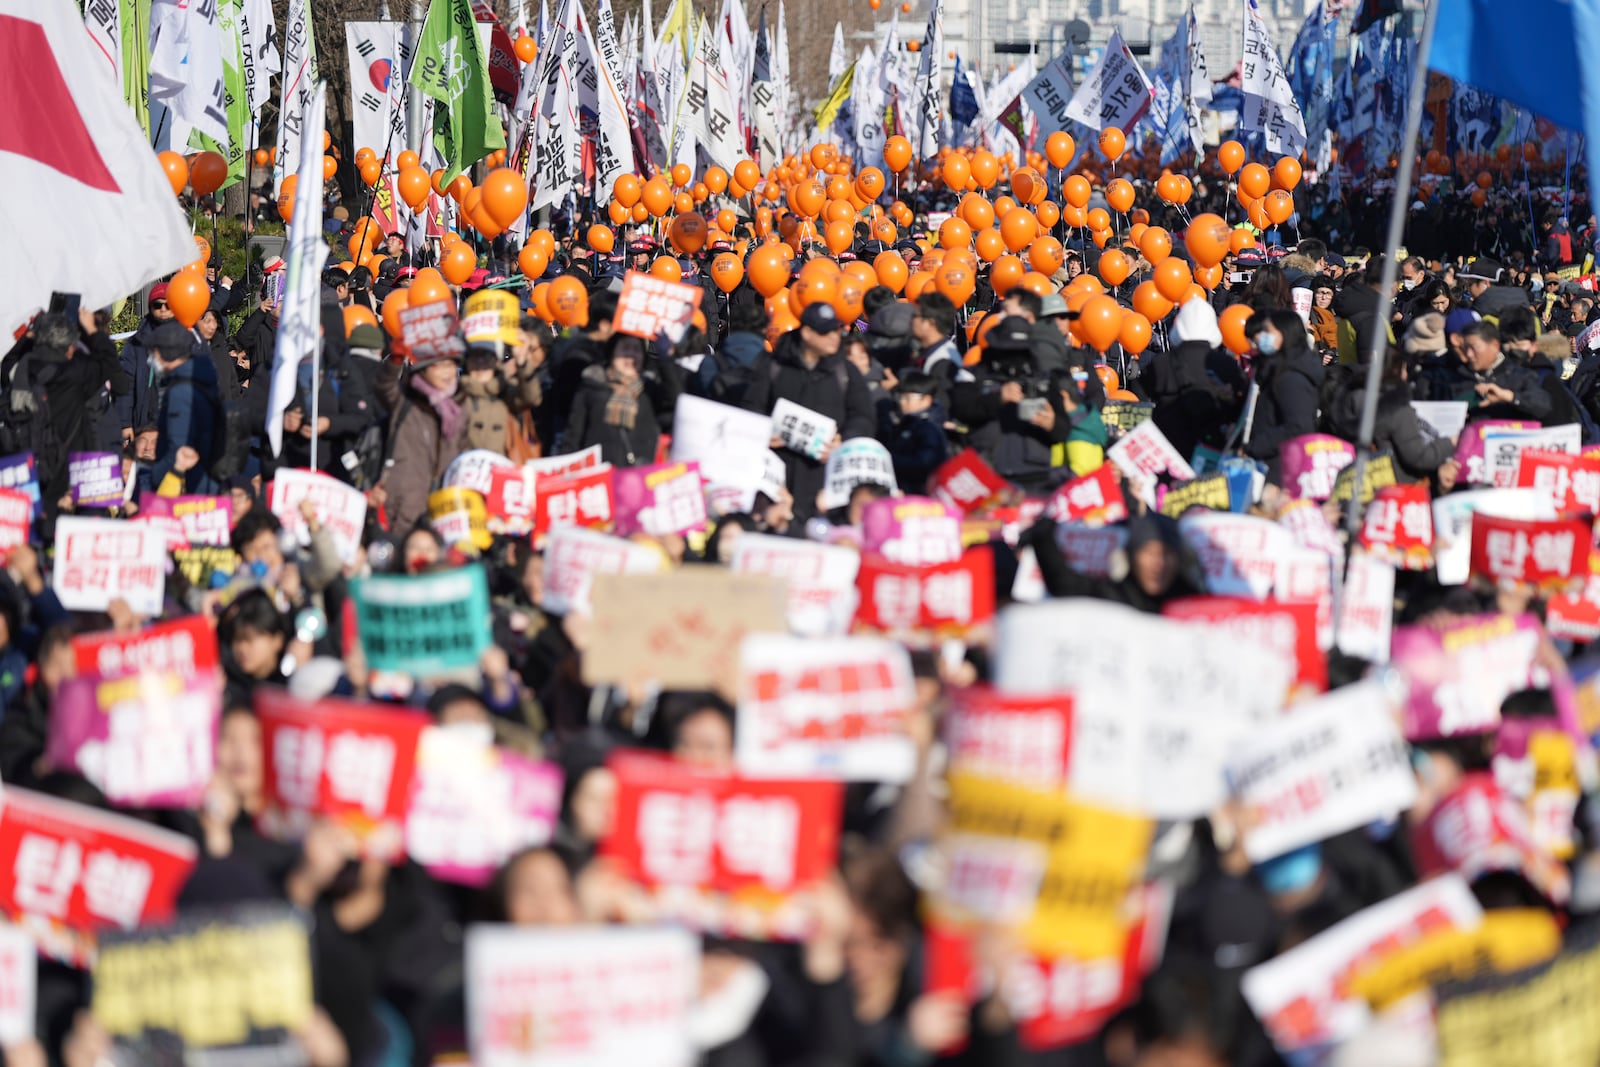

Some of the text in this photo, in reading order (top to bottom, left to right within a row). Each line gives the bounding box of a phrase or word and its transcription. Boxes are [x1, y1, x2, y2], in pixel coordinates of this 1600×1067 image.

[546, 483, 611, 528] 탄핵
[1534, 465, 1600, 515] 탄핵
[1364, 499, 1434, 546] 탄핵
[1486, 529, 1576, 579] 탄핵
[873, 568, 974, 628] 탄핵
[274, 724, 398, 817] 탄핵
[636, 791, 801, 889] 탄핵
[12, 834, 154, 933] 탄핵
